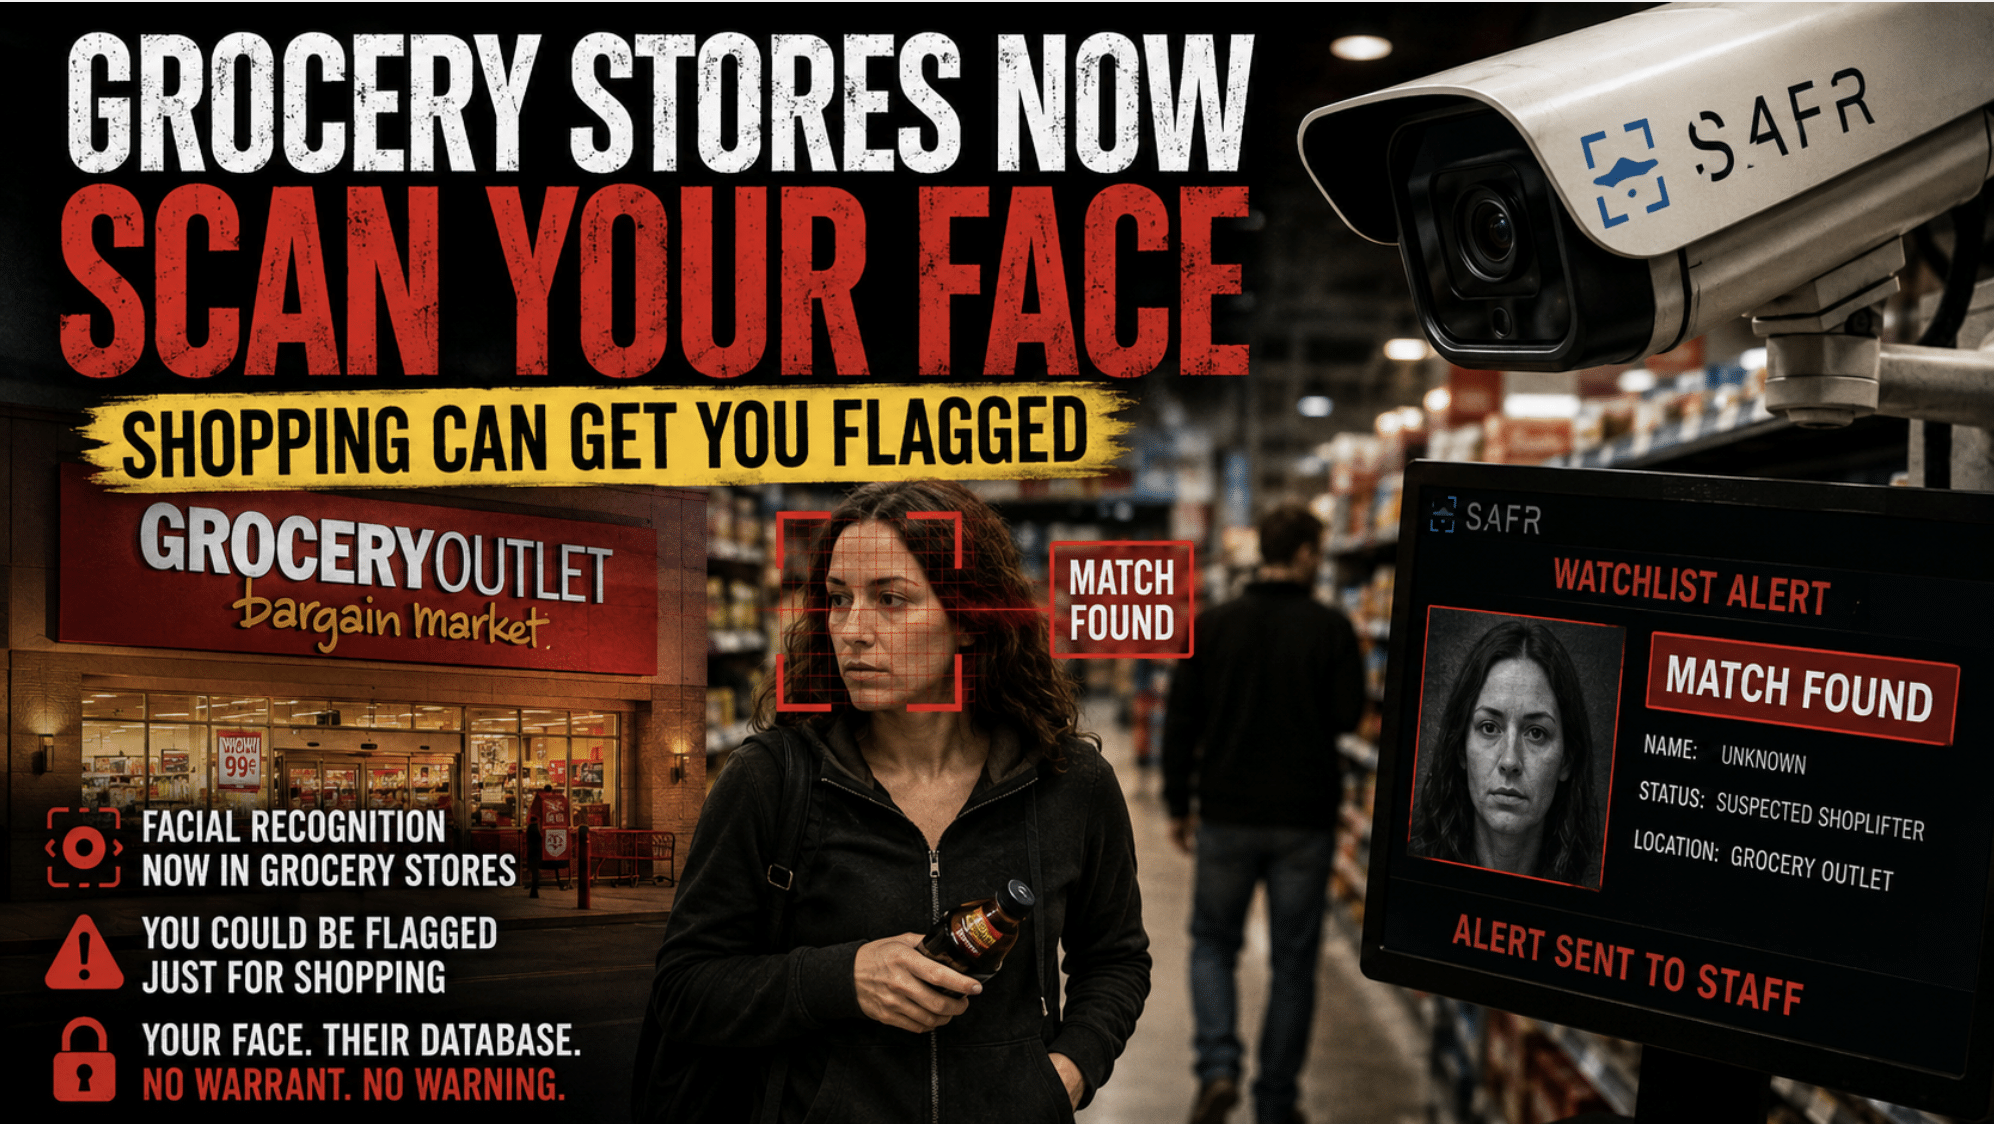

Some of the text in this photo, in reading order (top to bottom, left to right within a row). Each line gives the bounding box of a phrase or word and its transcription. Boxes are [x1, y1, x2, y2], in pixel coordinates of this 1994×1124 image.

[1688, 67, 1875, 182] SAFR
[1466, 502, 1541, 535] SAFR
[232, 577, 401, 653] bargain
[1554, 557, 1831, 616] WATCHLIST ALERT
[1666, 654, 1933, 723] MATCH FOUND
[1643, 733, 1807, 775] NAME: UNKNOWN
[1638, 780, 1925, 842] STATUS: SUSPECTED SHOPLIFTER
[1633, 829, 1895, 892] LOCATION: GROCERY OUTLET
[1452, 913, 1804, 1016] ALERT SENT TO STAFF
